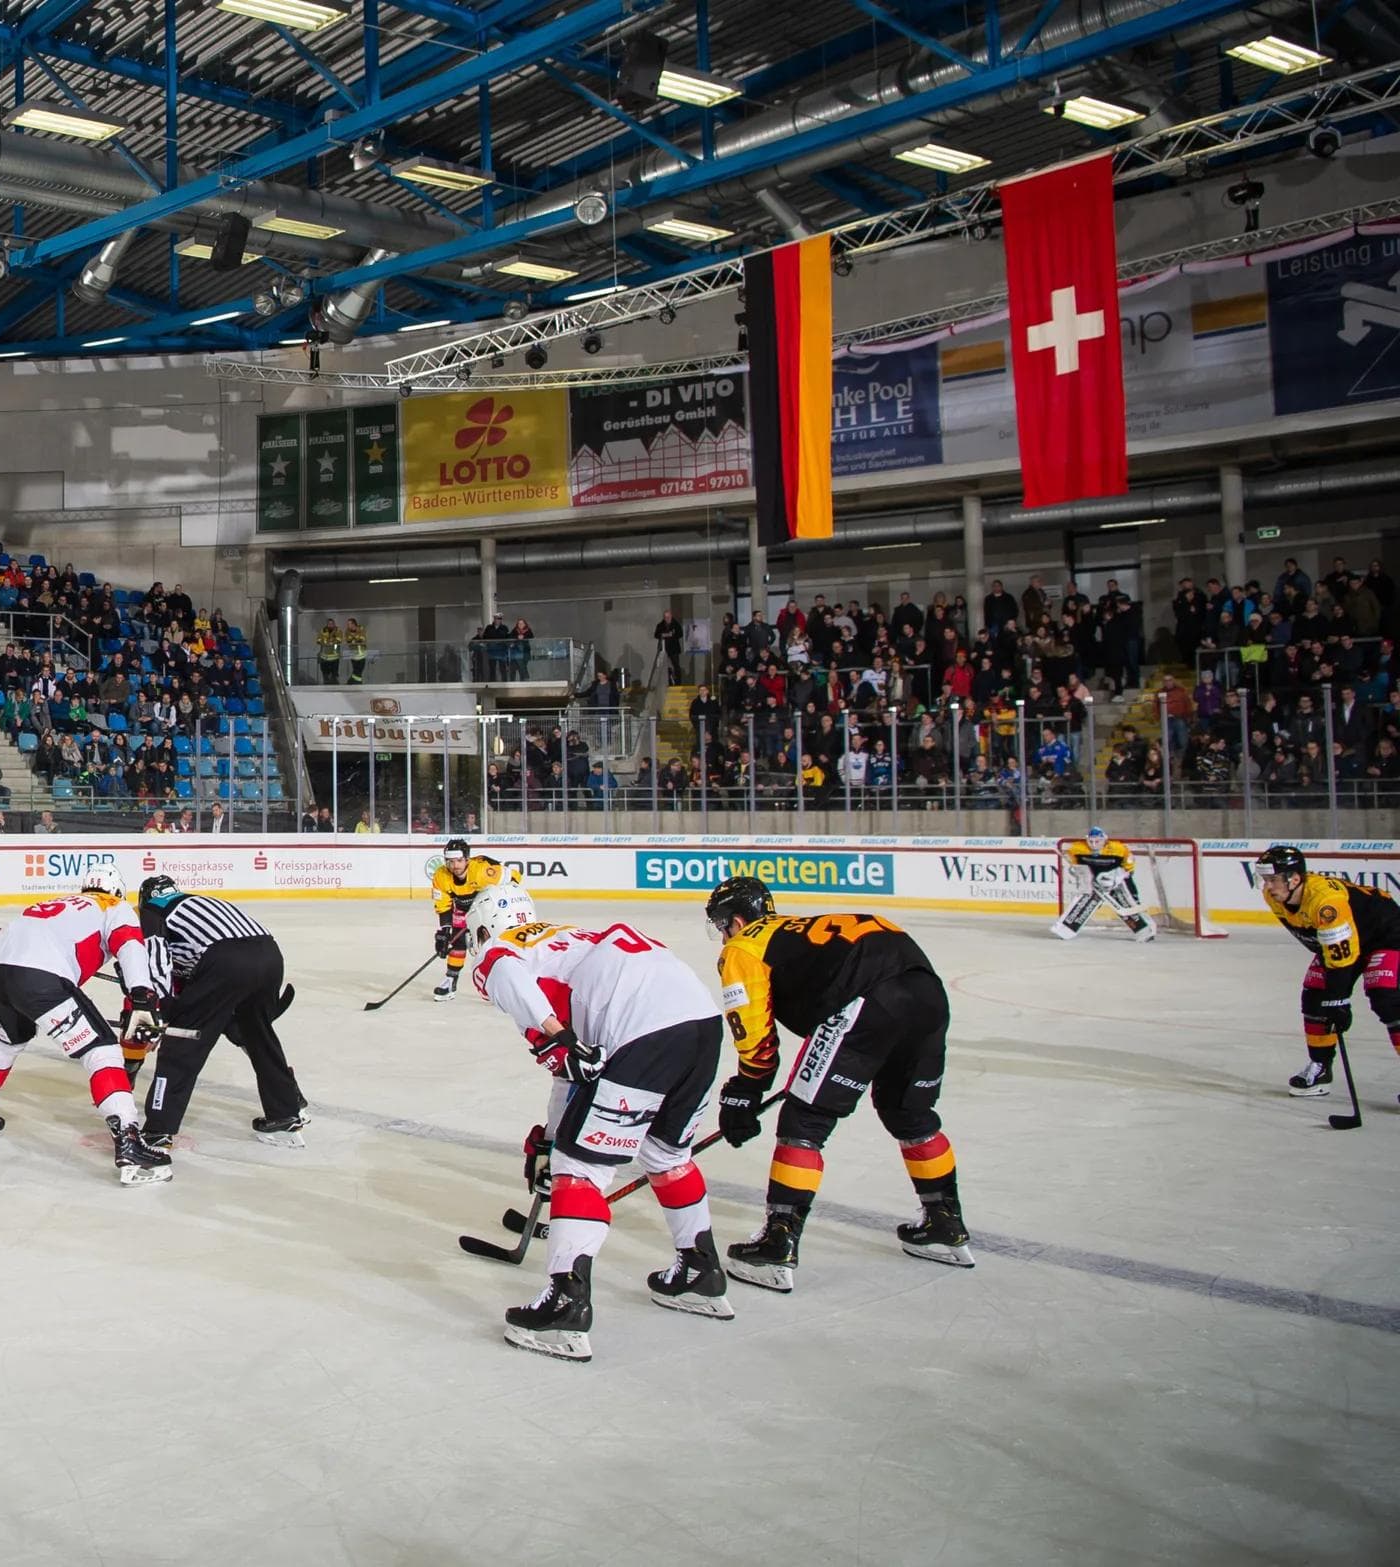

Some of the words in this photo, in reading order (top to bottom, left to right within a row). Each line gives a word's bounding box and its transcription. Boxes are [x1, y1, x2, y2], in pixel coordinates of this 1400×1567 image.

[1277, 244, 1371, 279] Leistung
[645, 388, 671, 409] DI
[678, 377, 735, 404] VITO
[868, 376, 913, 402] Pool
[603, 412, 671, 432] Gerüstbau
[674, 405, 717, 423] GmbH
[883, 424, 915, 437] ALLE
[439, 453, 531, 487] LOTTO
[660, 479, 695, 495] 07142
[709, 474, 744, 489] 97910
[412, 484, 561, 511] Baden-Württemberg
[318, 719, 464, 744] Bitburger
[1340, 842, 1395, 850] BAUER
[161, 861, 235, 872] Kreissparkasse
[273, 860, 353, 872] Kreissparkasse
[645, 854, 885, 889] sportwetten.de
[274, 875, 342, 889] Ludwigsburg
[516, 912, 527, 924] 50
[1328, 939, 1352, 961] 38
[604, 1136, 640, 1150] SWISS
